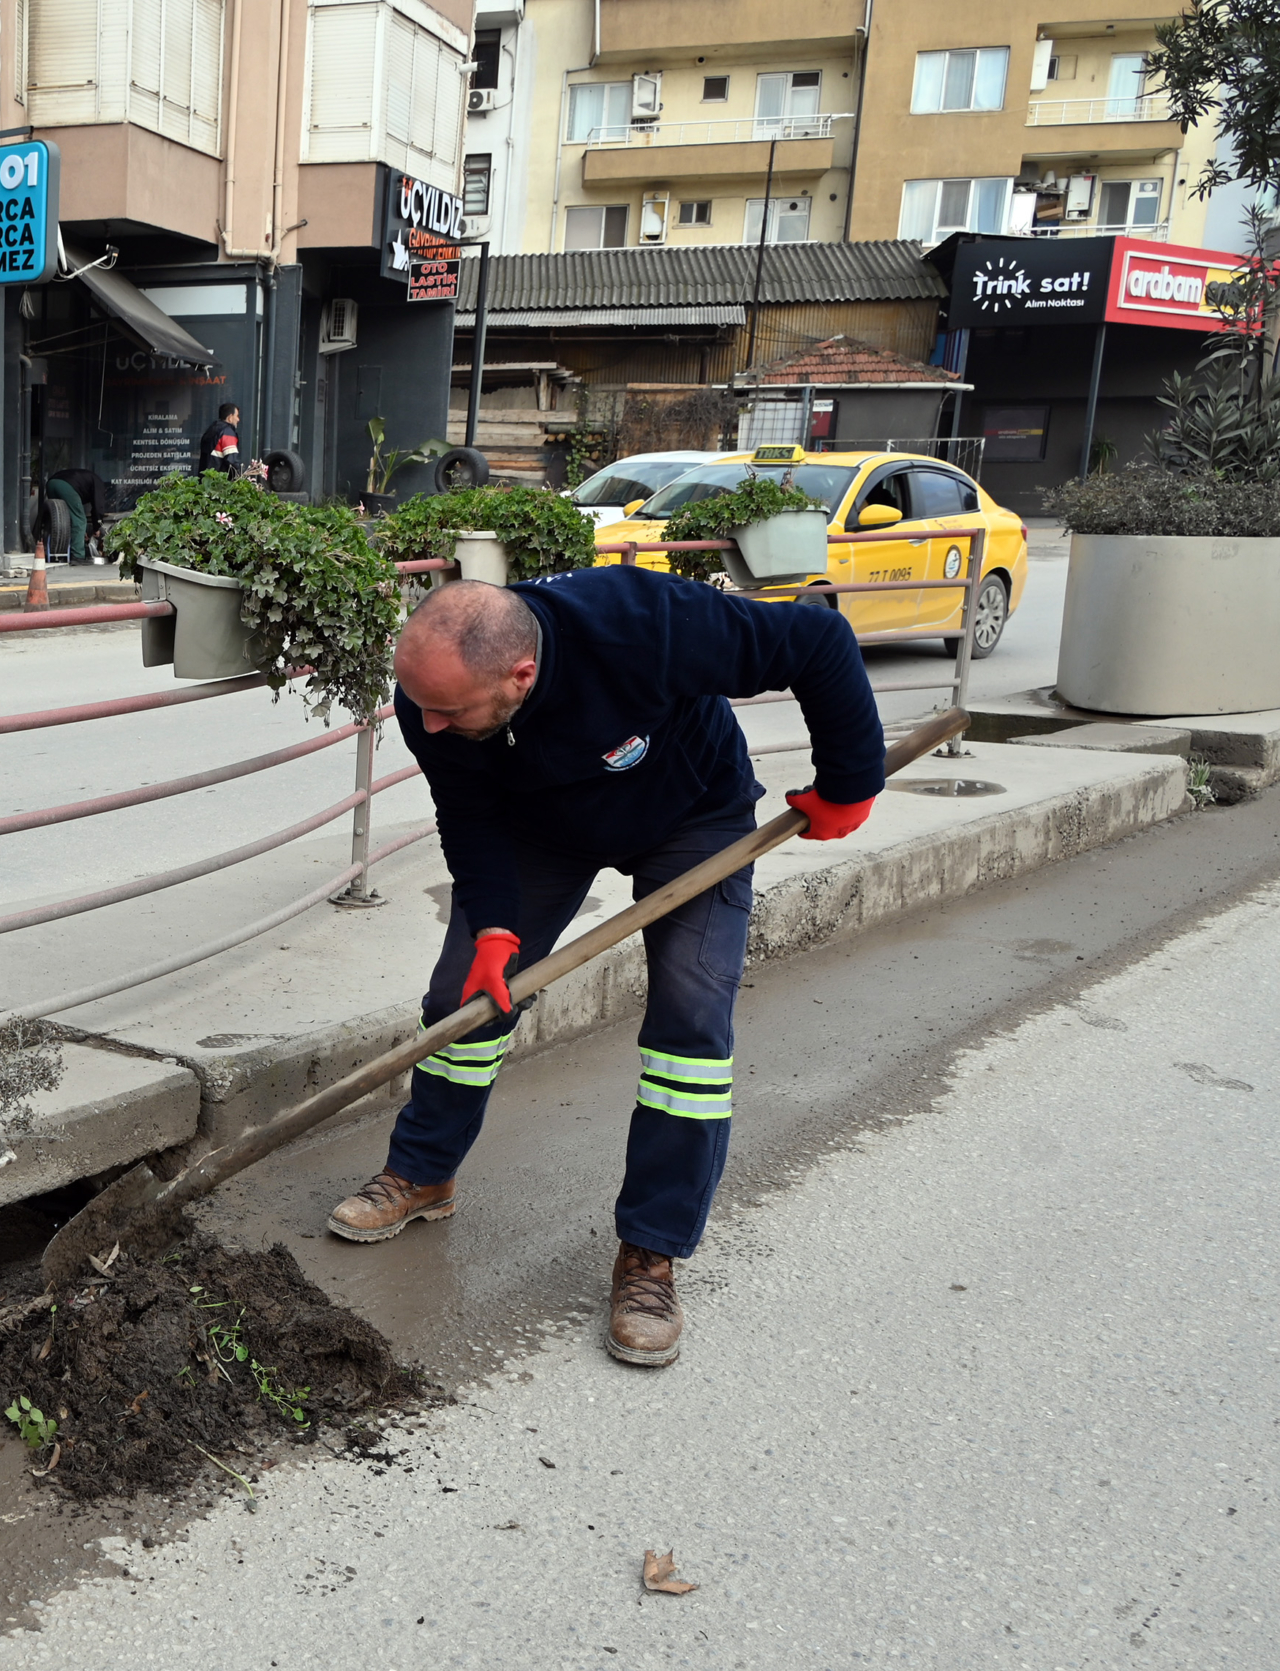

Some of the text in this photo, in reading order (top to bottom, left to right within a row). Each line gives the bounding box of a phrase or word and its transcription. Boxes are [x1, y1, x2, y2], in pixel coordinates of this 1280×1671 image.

[400, 176, 464, 240] ÜÇYILDIZ
[421, 262, 448, 274] OTO
[410, 272, 457, 287] LASTİK
[972, 271, 1091, 295] Trink sat!
[1127, 265, 1203, 304] arabam
[410, 284, 455, 299] TAMİRİ
[1024, 298, 1085, 308] Alım Noktası
[160, 437, 190, 447] DÖNÜŞÜM
[163, 451, 191, 460] SATIŞLAR
[130, 463, 192, 472] ÜCRETSİZ EKSPERTİZ
[123, 477, 153, 486] KARŞILIĞI
[869, 566, 912, 583] 77 T 0095
